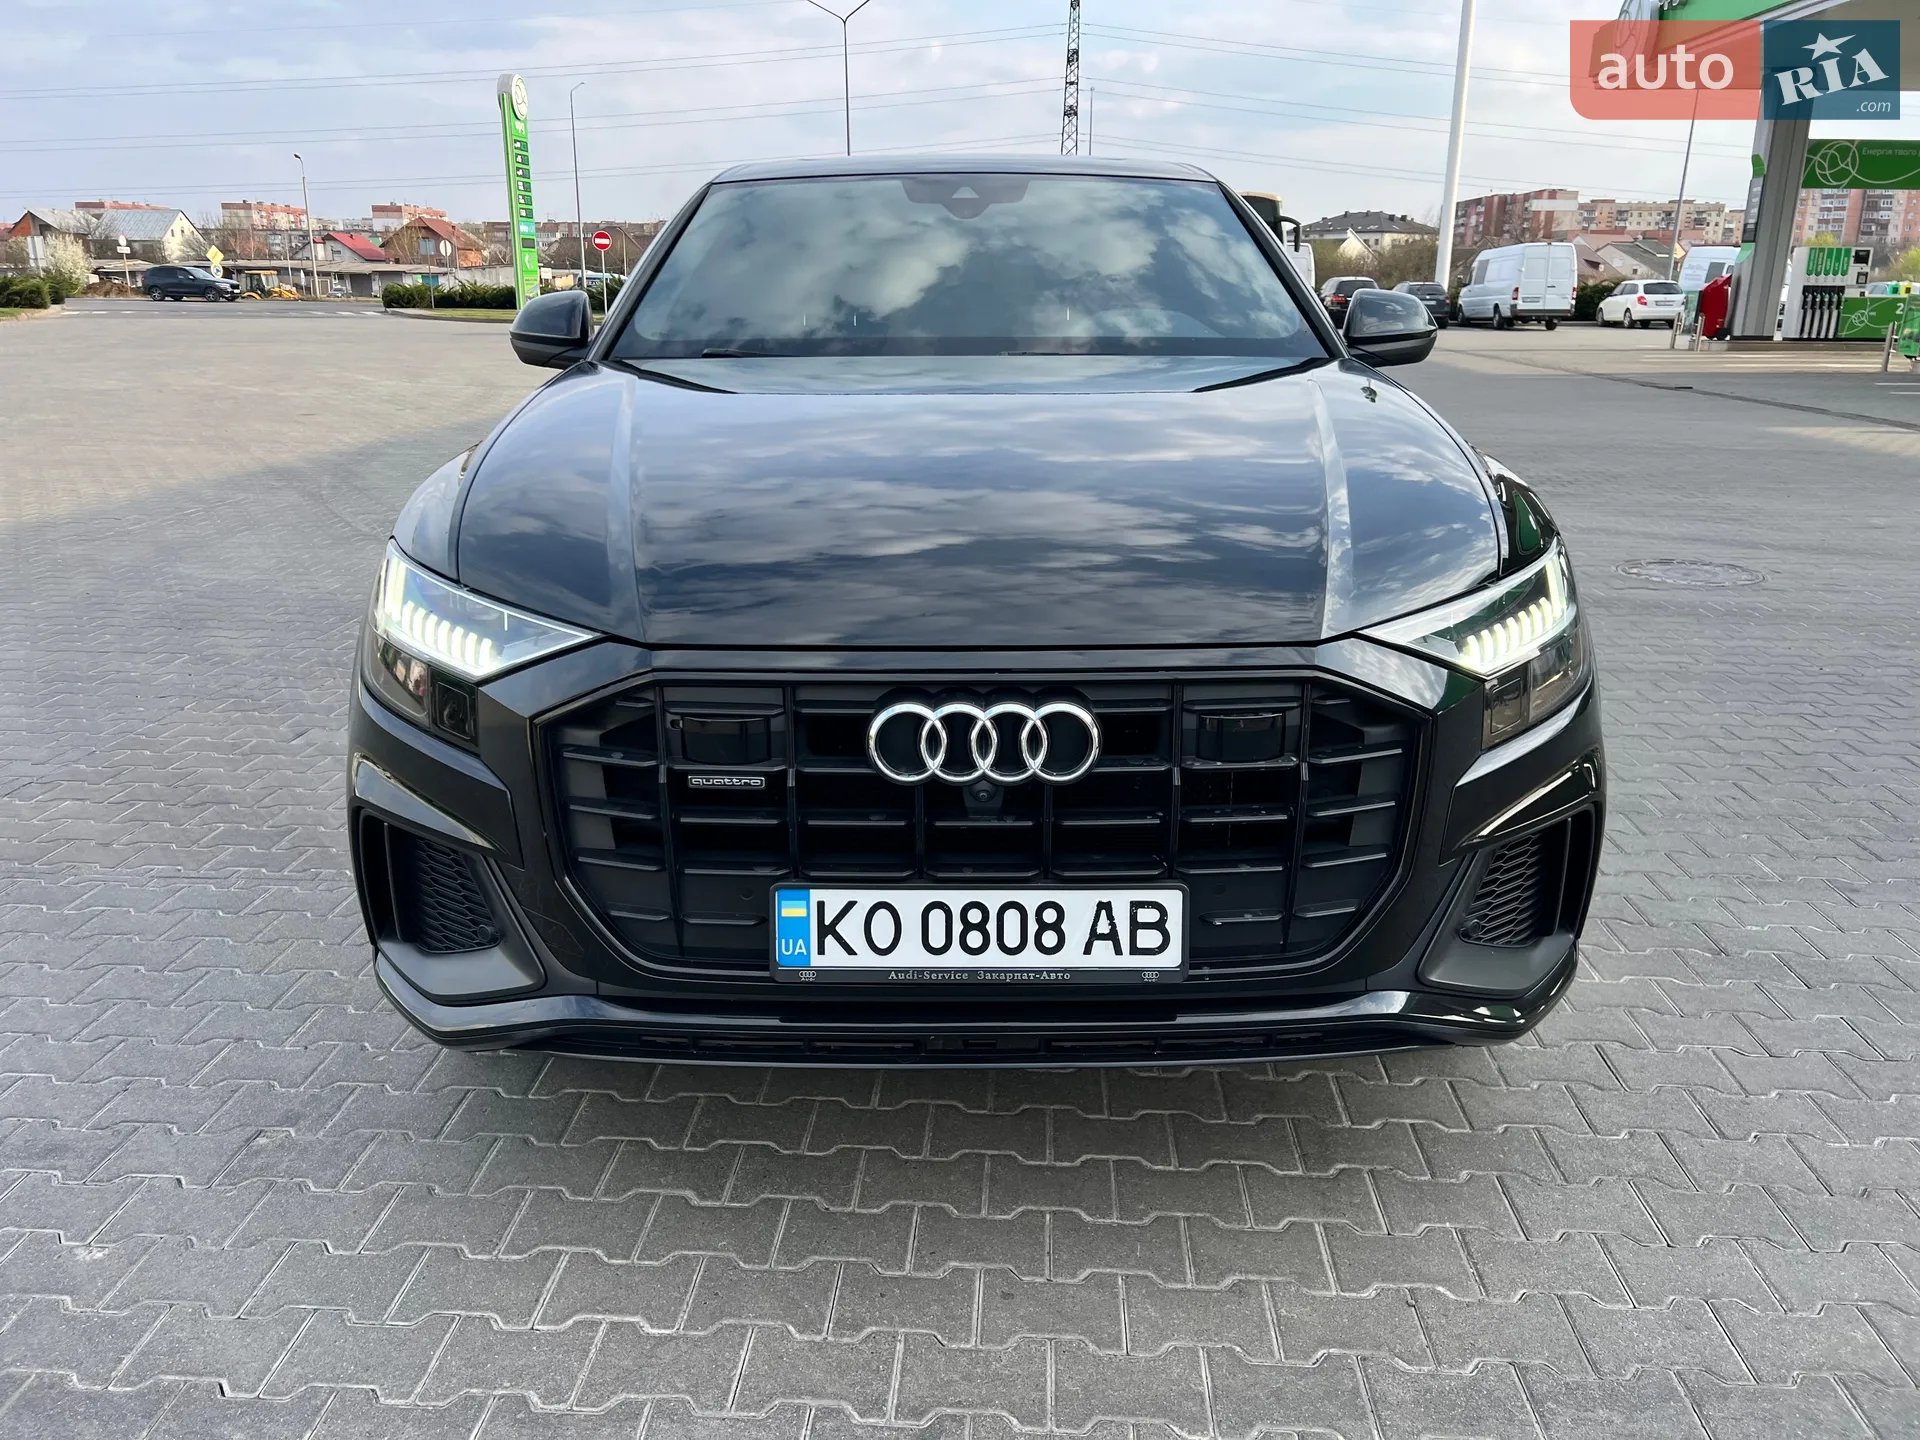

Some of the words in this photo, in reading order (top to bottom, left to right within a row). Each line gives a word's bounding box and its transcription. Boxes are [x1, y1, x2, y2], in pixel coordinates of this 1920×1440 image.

[691, 778, 761, 786] quattro
[817, 900, 902, 956] KO
[921, 900, 1066, 956] 0808
[1083, 900, 1171, 956] AB
[781, 938, 807, 956] UA
[888, 970, 969, 980] Audi-Service
[976, 970, 1071, 982] Закарпат-Авто
